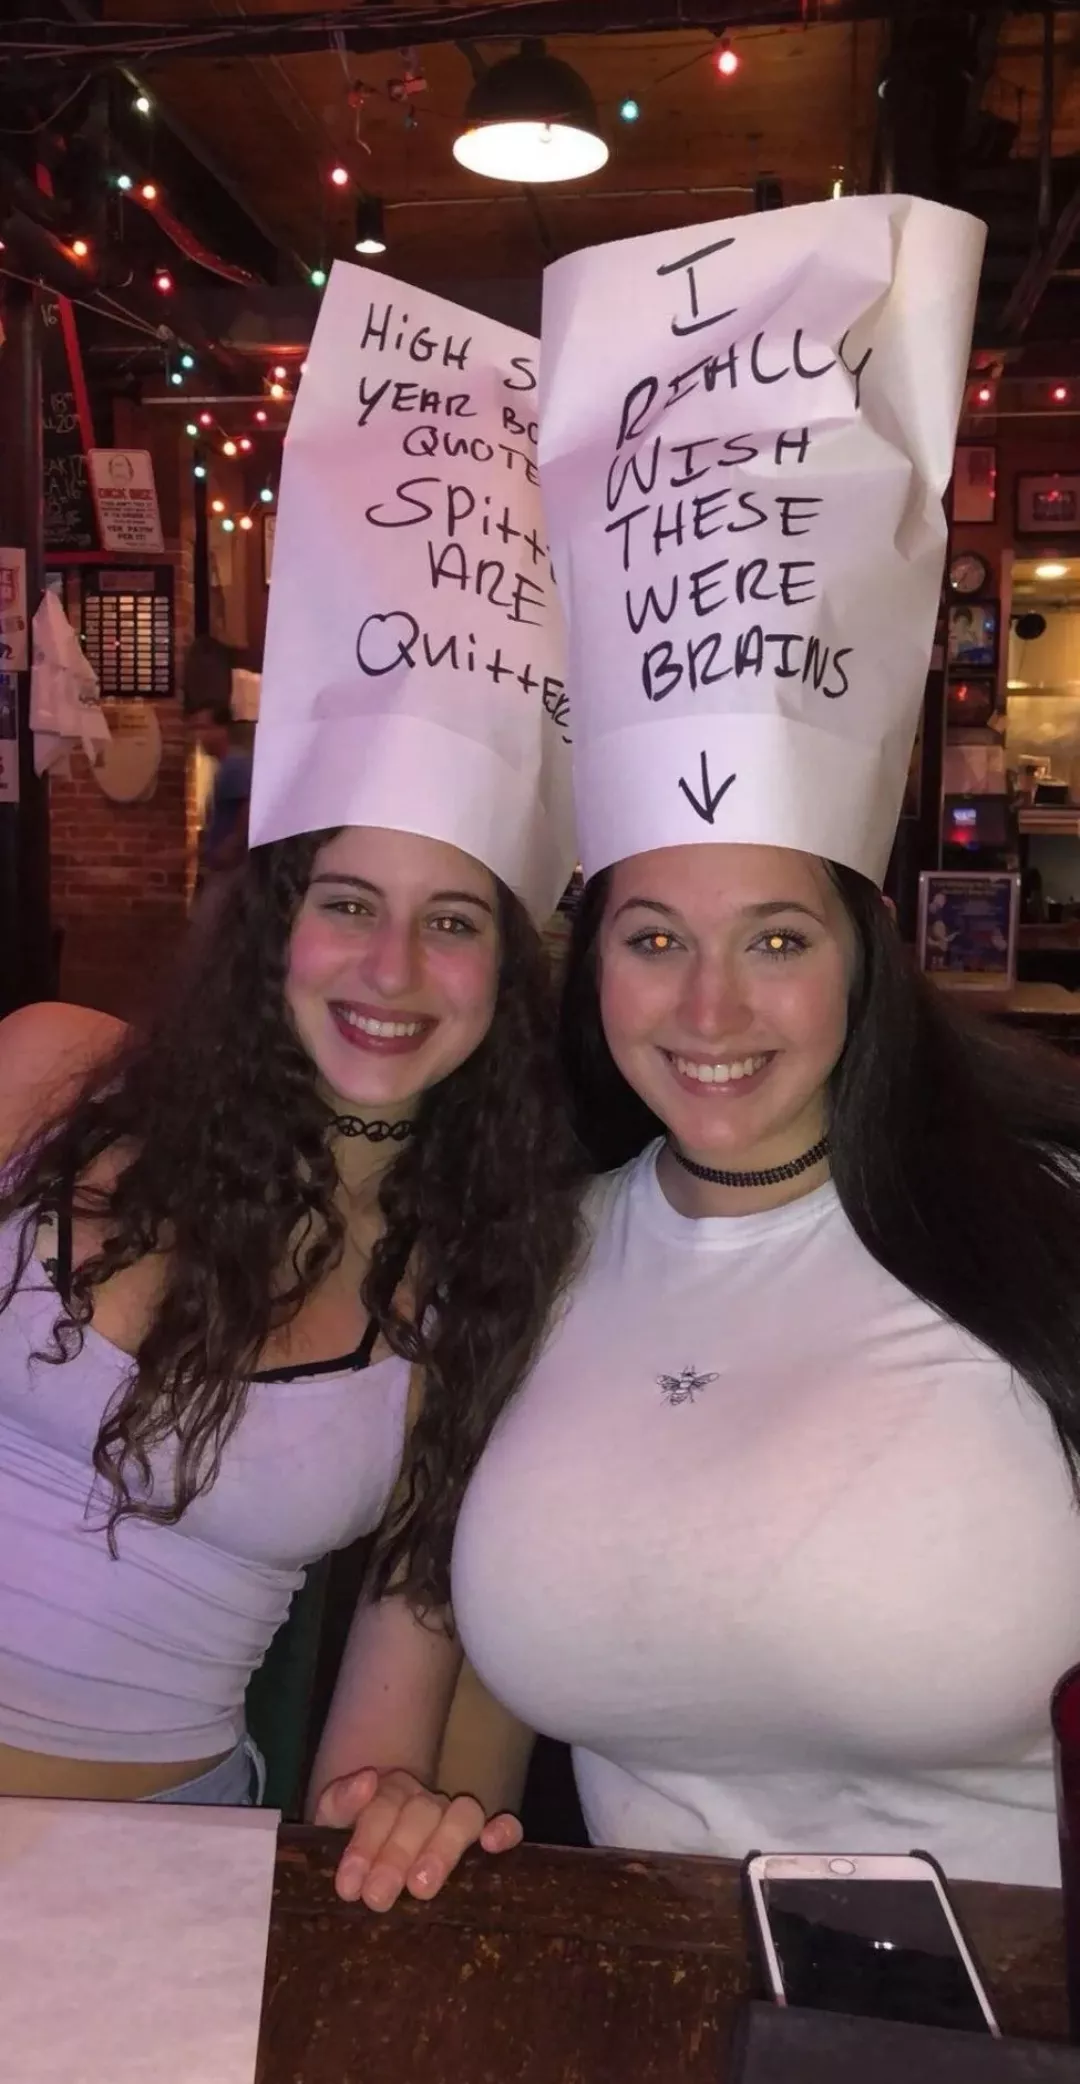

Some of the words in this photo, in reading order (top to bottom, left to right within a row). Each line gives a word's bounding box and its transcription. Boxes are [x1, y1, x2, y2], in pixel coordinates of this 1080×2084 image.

[656, 238, 737, 337] I
[357, 376, 478, 428] YEAR
[502, 406, 539, 446] BO
[502, 357, 538, 392] S
[615, 328, 873, 451] REALLY
[606, 427, 811, 512] WISH
[604, 488, 825, 573] THESE
[427, 540, 548, 629] ARE
[625, 557, 817, 635] WERE
[640, 624, 855, 703] BRAINS
